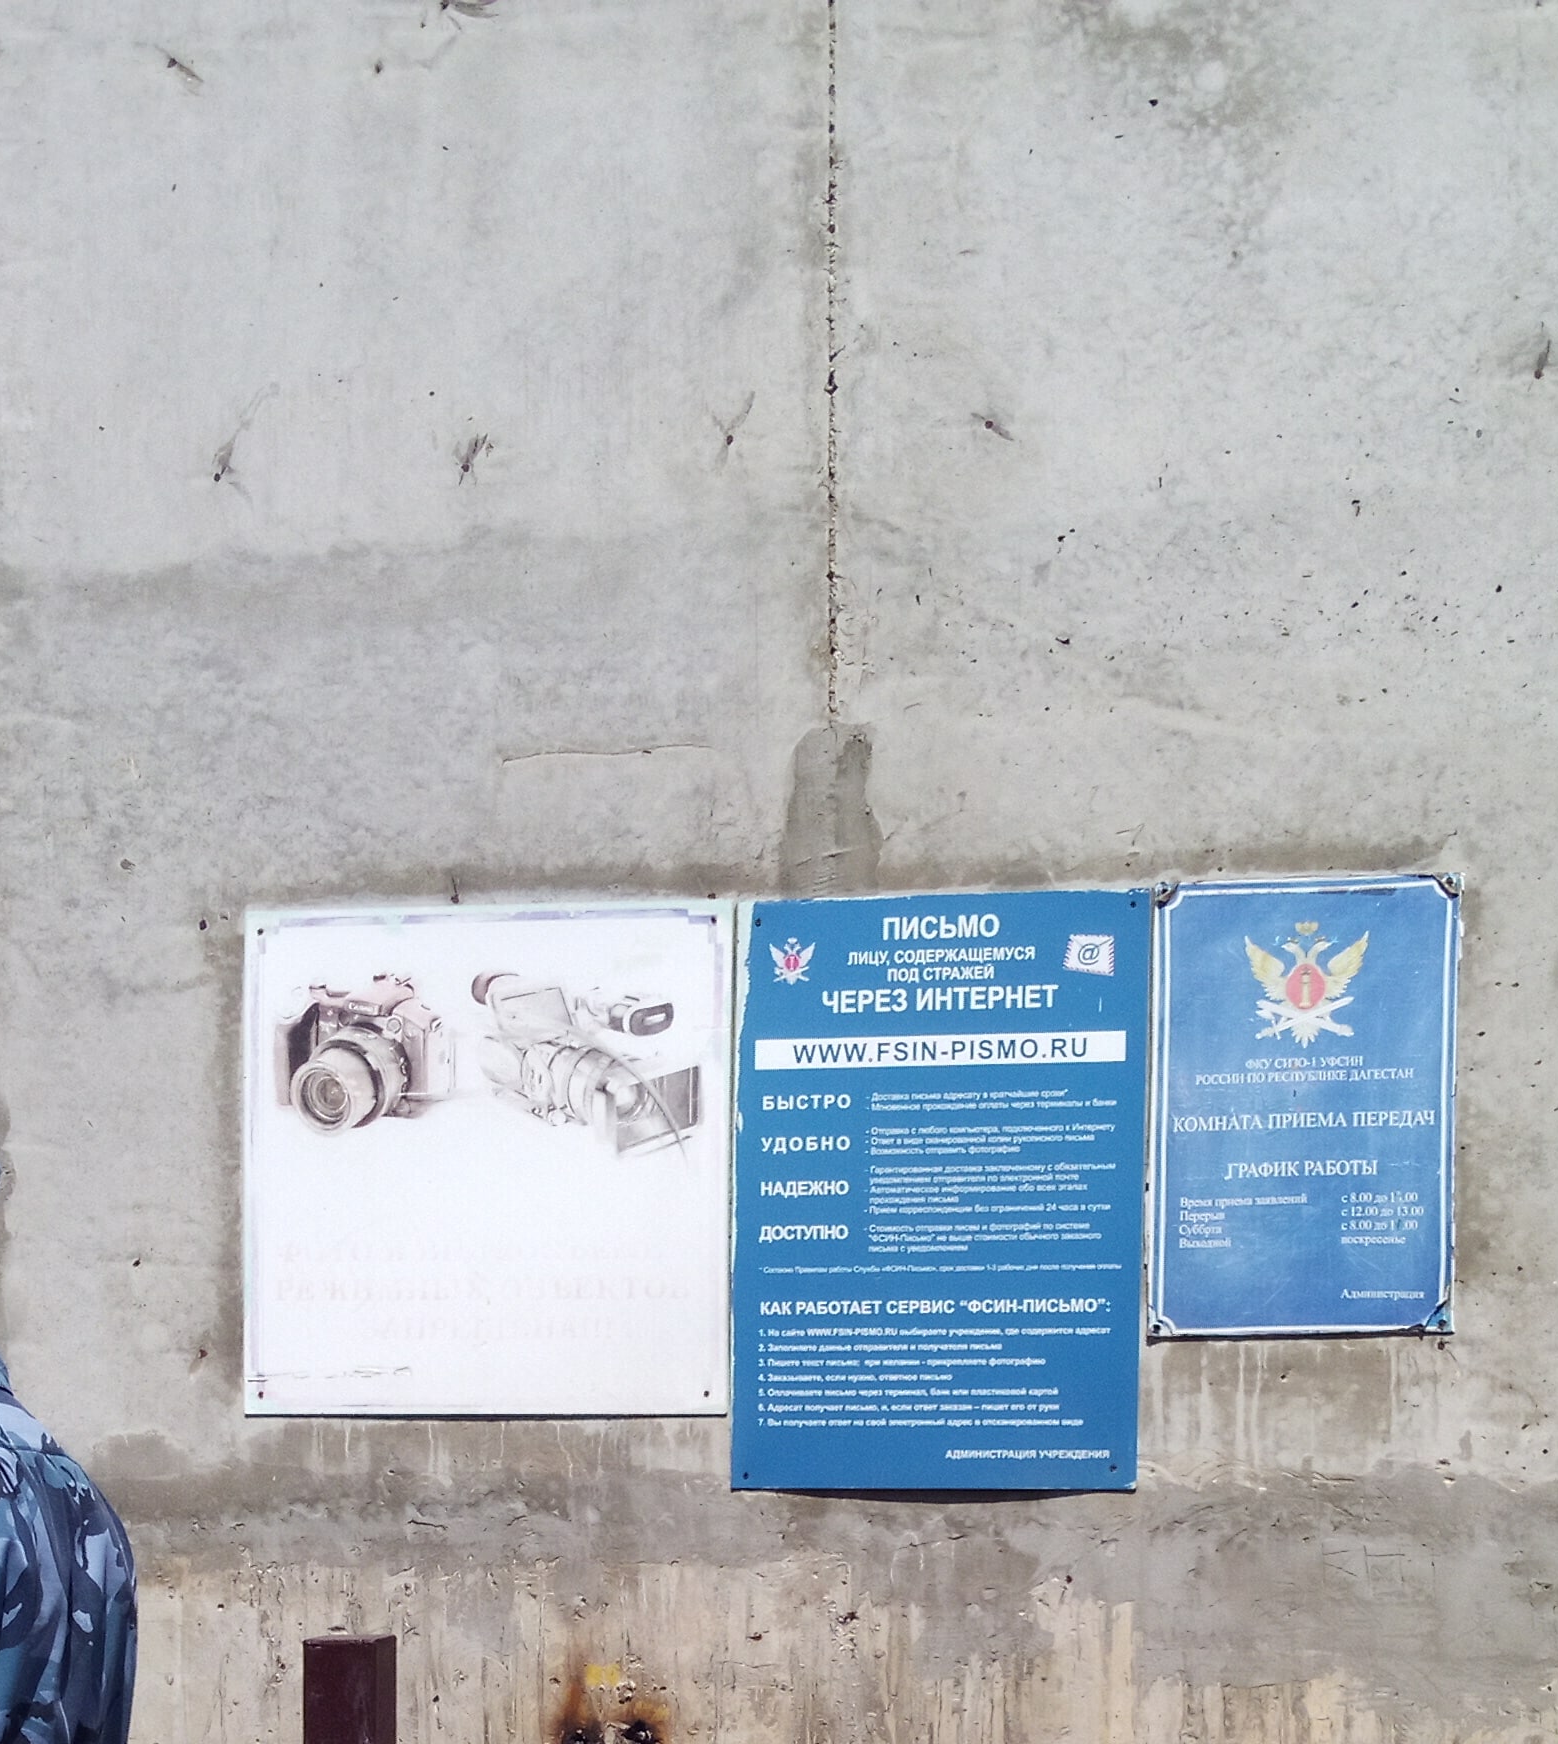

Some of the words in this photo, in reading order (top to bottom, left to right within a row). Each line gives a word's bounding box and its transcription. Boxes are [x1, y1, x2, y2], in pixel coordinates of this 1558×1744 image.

[882, 914, 1000, 940] ПИСЬМО
[847, 951, 890, 967] ЛИЦУ,
[894, 946, 1036, 965] СОДЕРЖАЩЕМУСЯ
[887, 968, 920, 983] ПОД
[923, 964, 995, 981] СТРАЖЕЙ
[822, 989, 908, 1014] ЧЕРЕЗ
[916, 984, 1059, 1012] ИНТЕРНЕТ
[793, 1037, 1089, 1064] WWW.FSIN-PISMO.RU
[1321, 1055, 1363, 1068] УФСИН
[1195, 1074, 1244, 1086] РОССИИ
[1248, 1073, 1264, 1084] ПО
[1268, 1070, 1347, 1083] РЕСПУБЛИКЕ
[1349, 1068, 1414, 1082] ДАГЕСТАН
[761, 1094, 852, 1111] БЫСТРО
[1173, 1113, 1263, 1132] КОМНАТА
[1268, 1111, 1347, 1129] ПРИЕМА
[1352, 1110, 1435, 1128] ПЕРЕДАЧ
[760, 1135, 852, 1153] УДОБНО
[1226, 1161, 1299, 1179] ГРАФИК
[1304, 1159, 1378, 1176] РАБОТЫ
[760, 1179, 849, 1197] НАДЕЖНО
[1349, 1192, 1372, 1203] 8.00
[1351, 1206, 1378, 1217] 12.00
[1397, 1206, 1424, 1217] 13.00
[759, 1225, 849, 1243] ДОСТУПНО
[1349, 1220, 1372, 1231] 8.00
[760, 1301, 792, 1315] КАК
[796, 1300, 883, 1315] РАБОТАЕТ
[886, 1299, 955, 1314] СЕРВИС
[945, 1449, 1037, 1460] АДМИНИСТРАЦИЯ
[1038, 1449, 1110, 1460] УЧРЕЖДЕНИЯ
